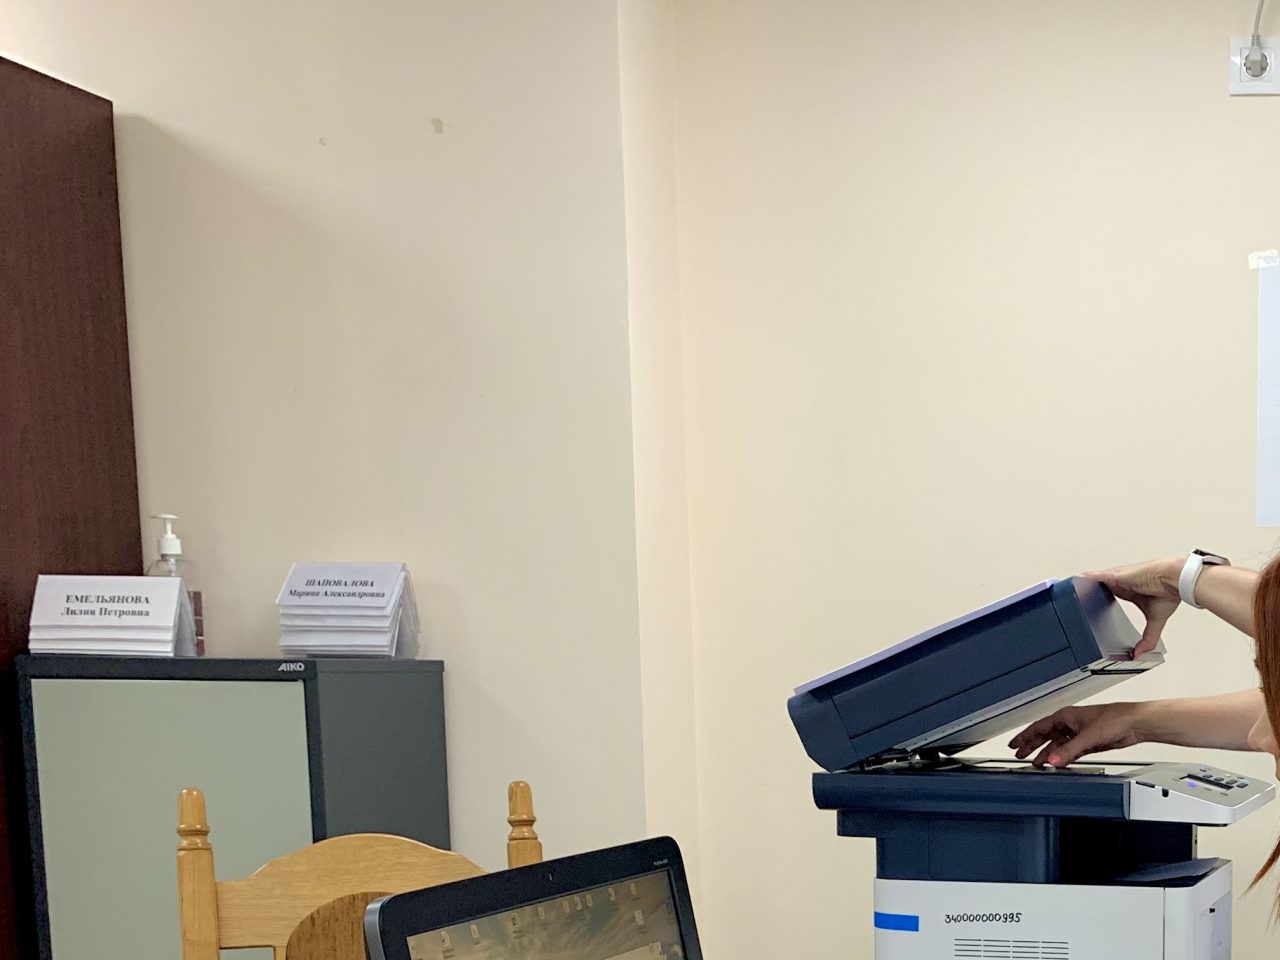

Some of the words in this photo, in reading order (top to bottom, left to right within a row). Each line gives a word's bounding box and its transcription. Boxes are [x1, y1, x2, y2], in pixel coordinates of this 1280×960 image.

[305, 579, 374, 588] ШАПОВАЛОВА
[65, 594, 150, 604] ЕМЕЛЬЯНОВА
[289, 589, 321, 598] Марина
[323, 590, 386, 599] Александровна
[98, 607, 150, 618] Петровна
[278, 662, 305, 671] AIKO
